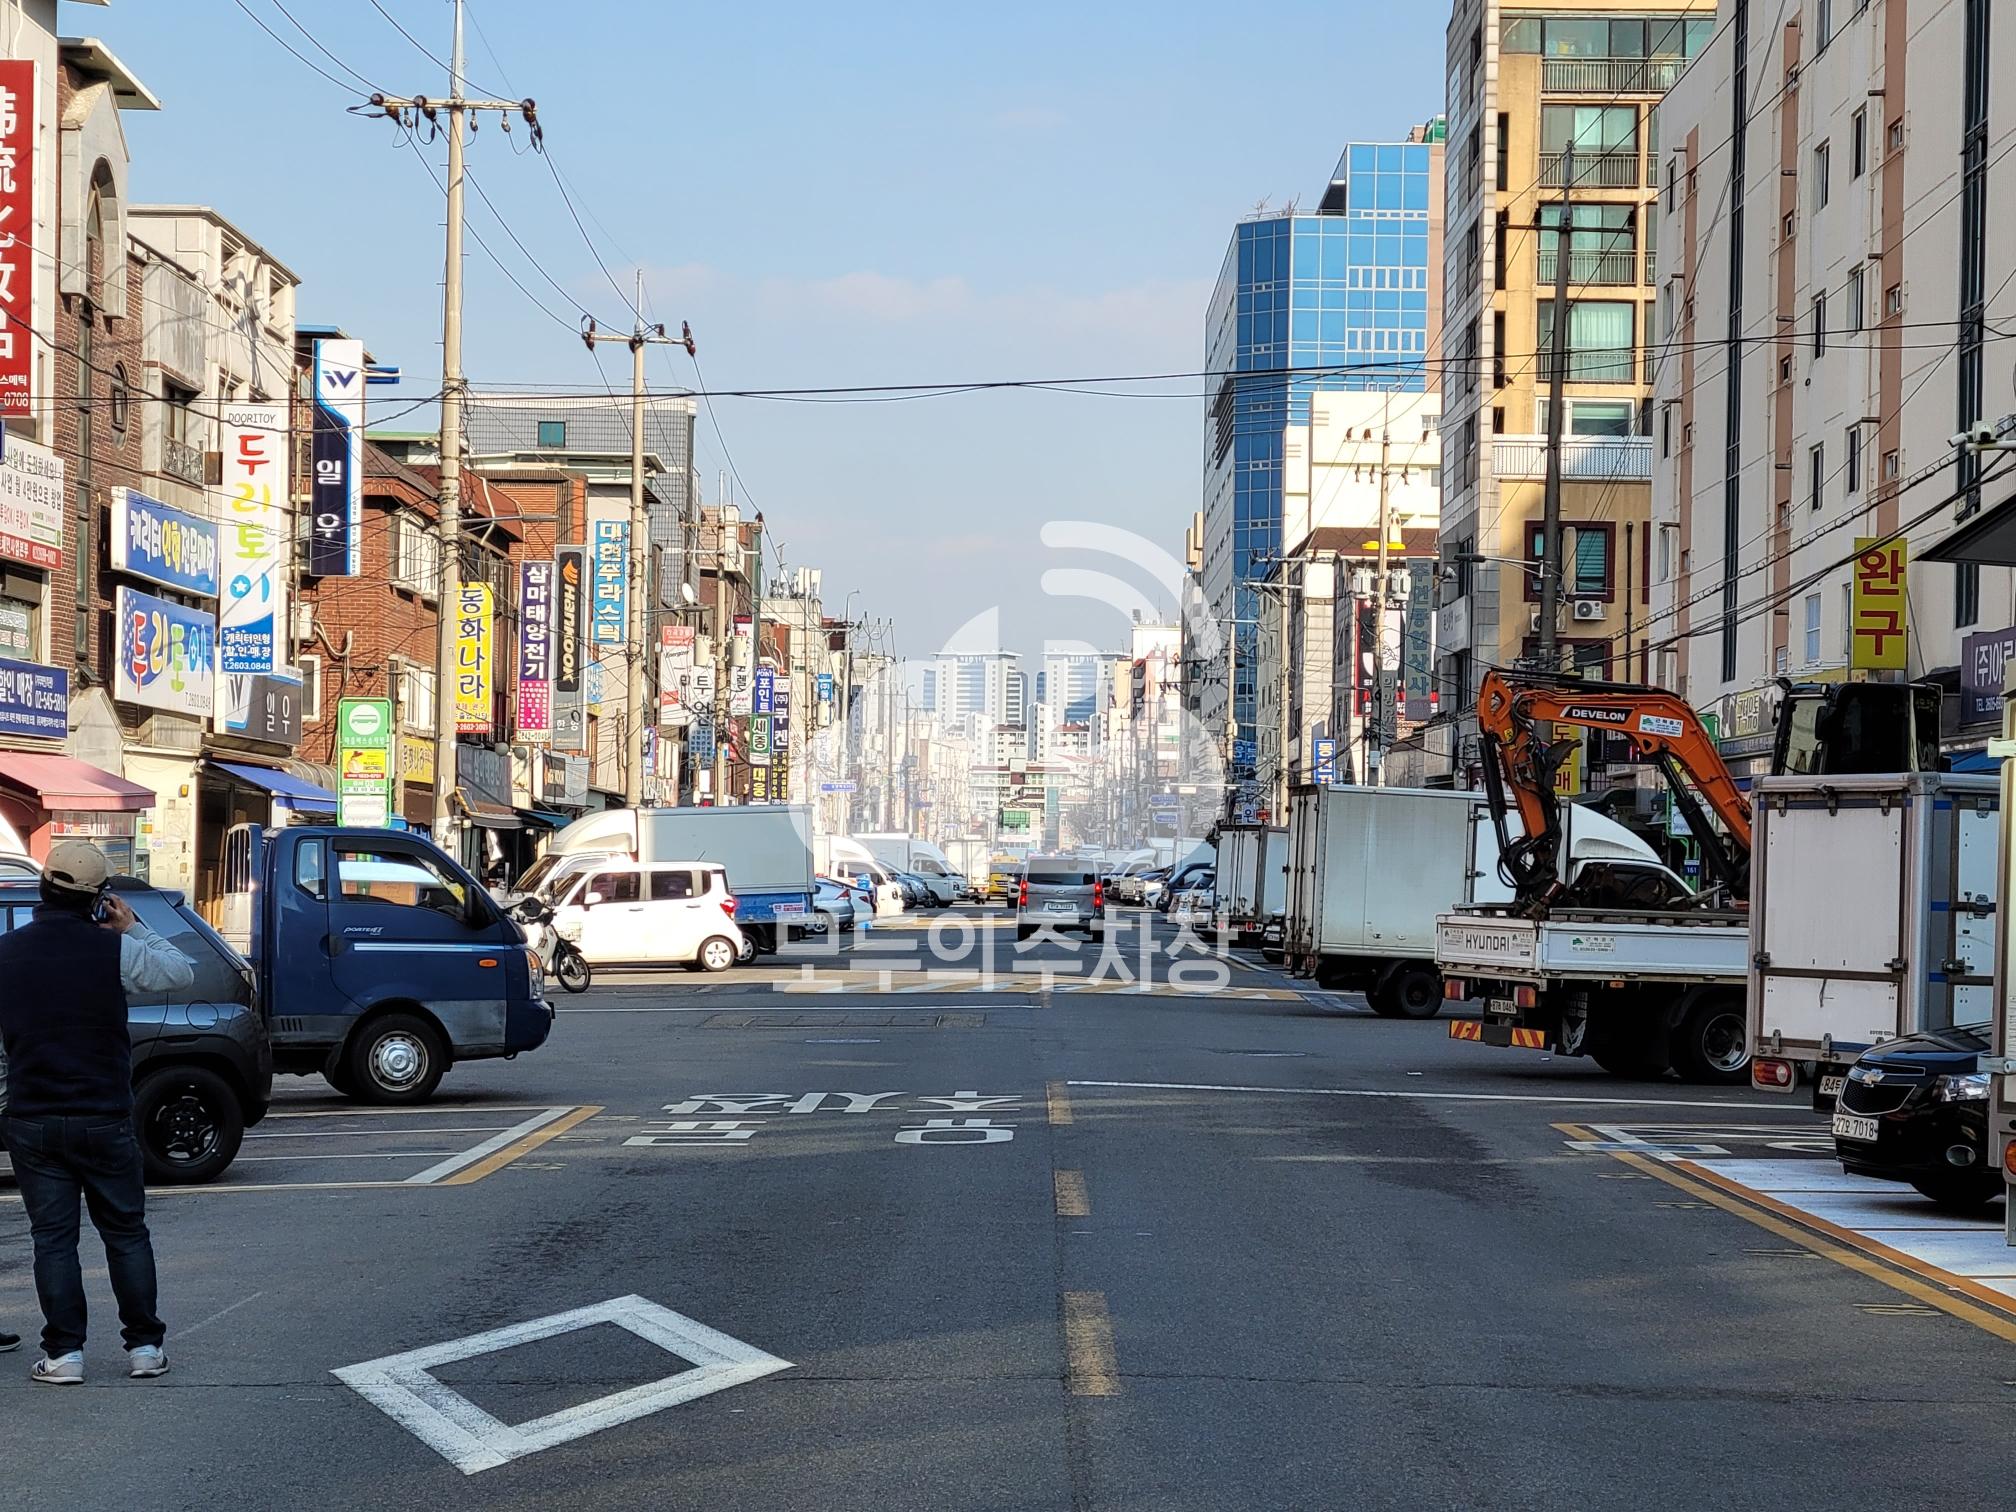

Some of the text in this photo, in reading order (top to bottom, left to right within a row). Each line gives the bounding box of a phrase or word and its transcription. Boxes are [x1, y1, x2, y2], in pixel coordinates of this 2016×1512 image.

[228, 413, 277, 425] DOORITOY
[230, 434, 271, 603] 두리토이
[315, 459, 343, 538] 일우
[525, 566, 549, 679] 삼마태양전기
[1858, 549, 1905, 656] 완구
[132, 610, 209, 695] 두리토이
[225, 633, 271, 645] 캐릭터인형
[459, 588, 486, 700] 동화나라
[758, 678, 771, 713] 포인트
[1572, 708, 1626, 721] DEVELON
[1465, 933, 1510, 952] HYUNDAI
[1853, 1119, 1875, 1138] 7018
